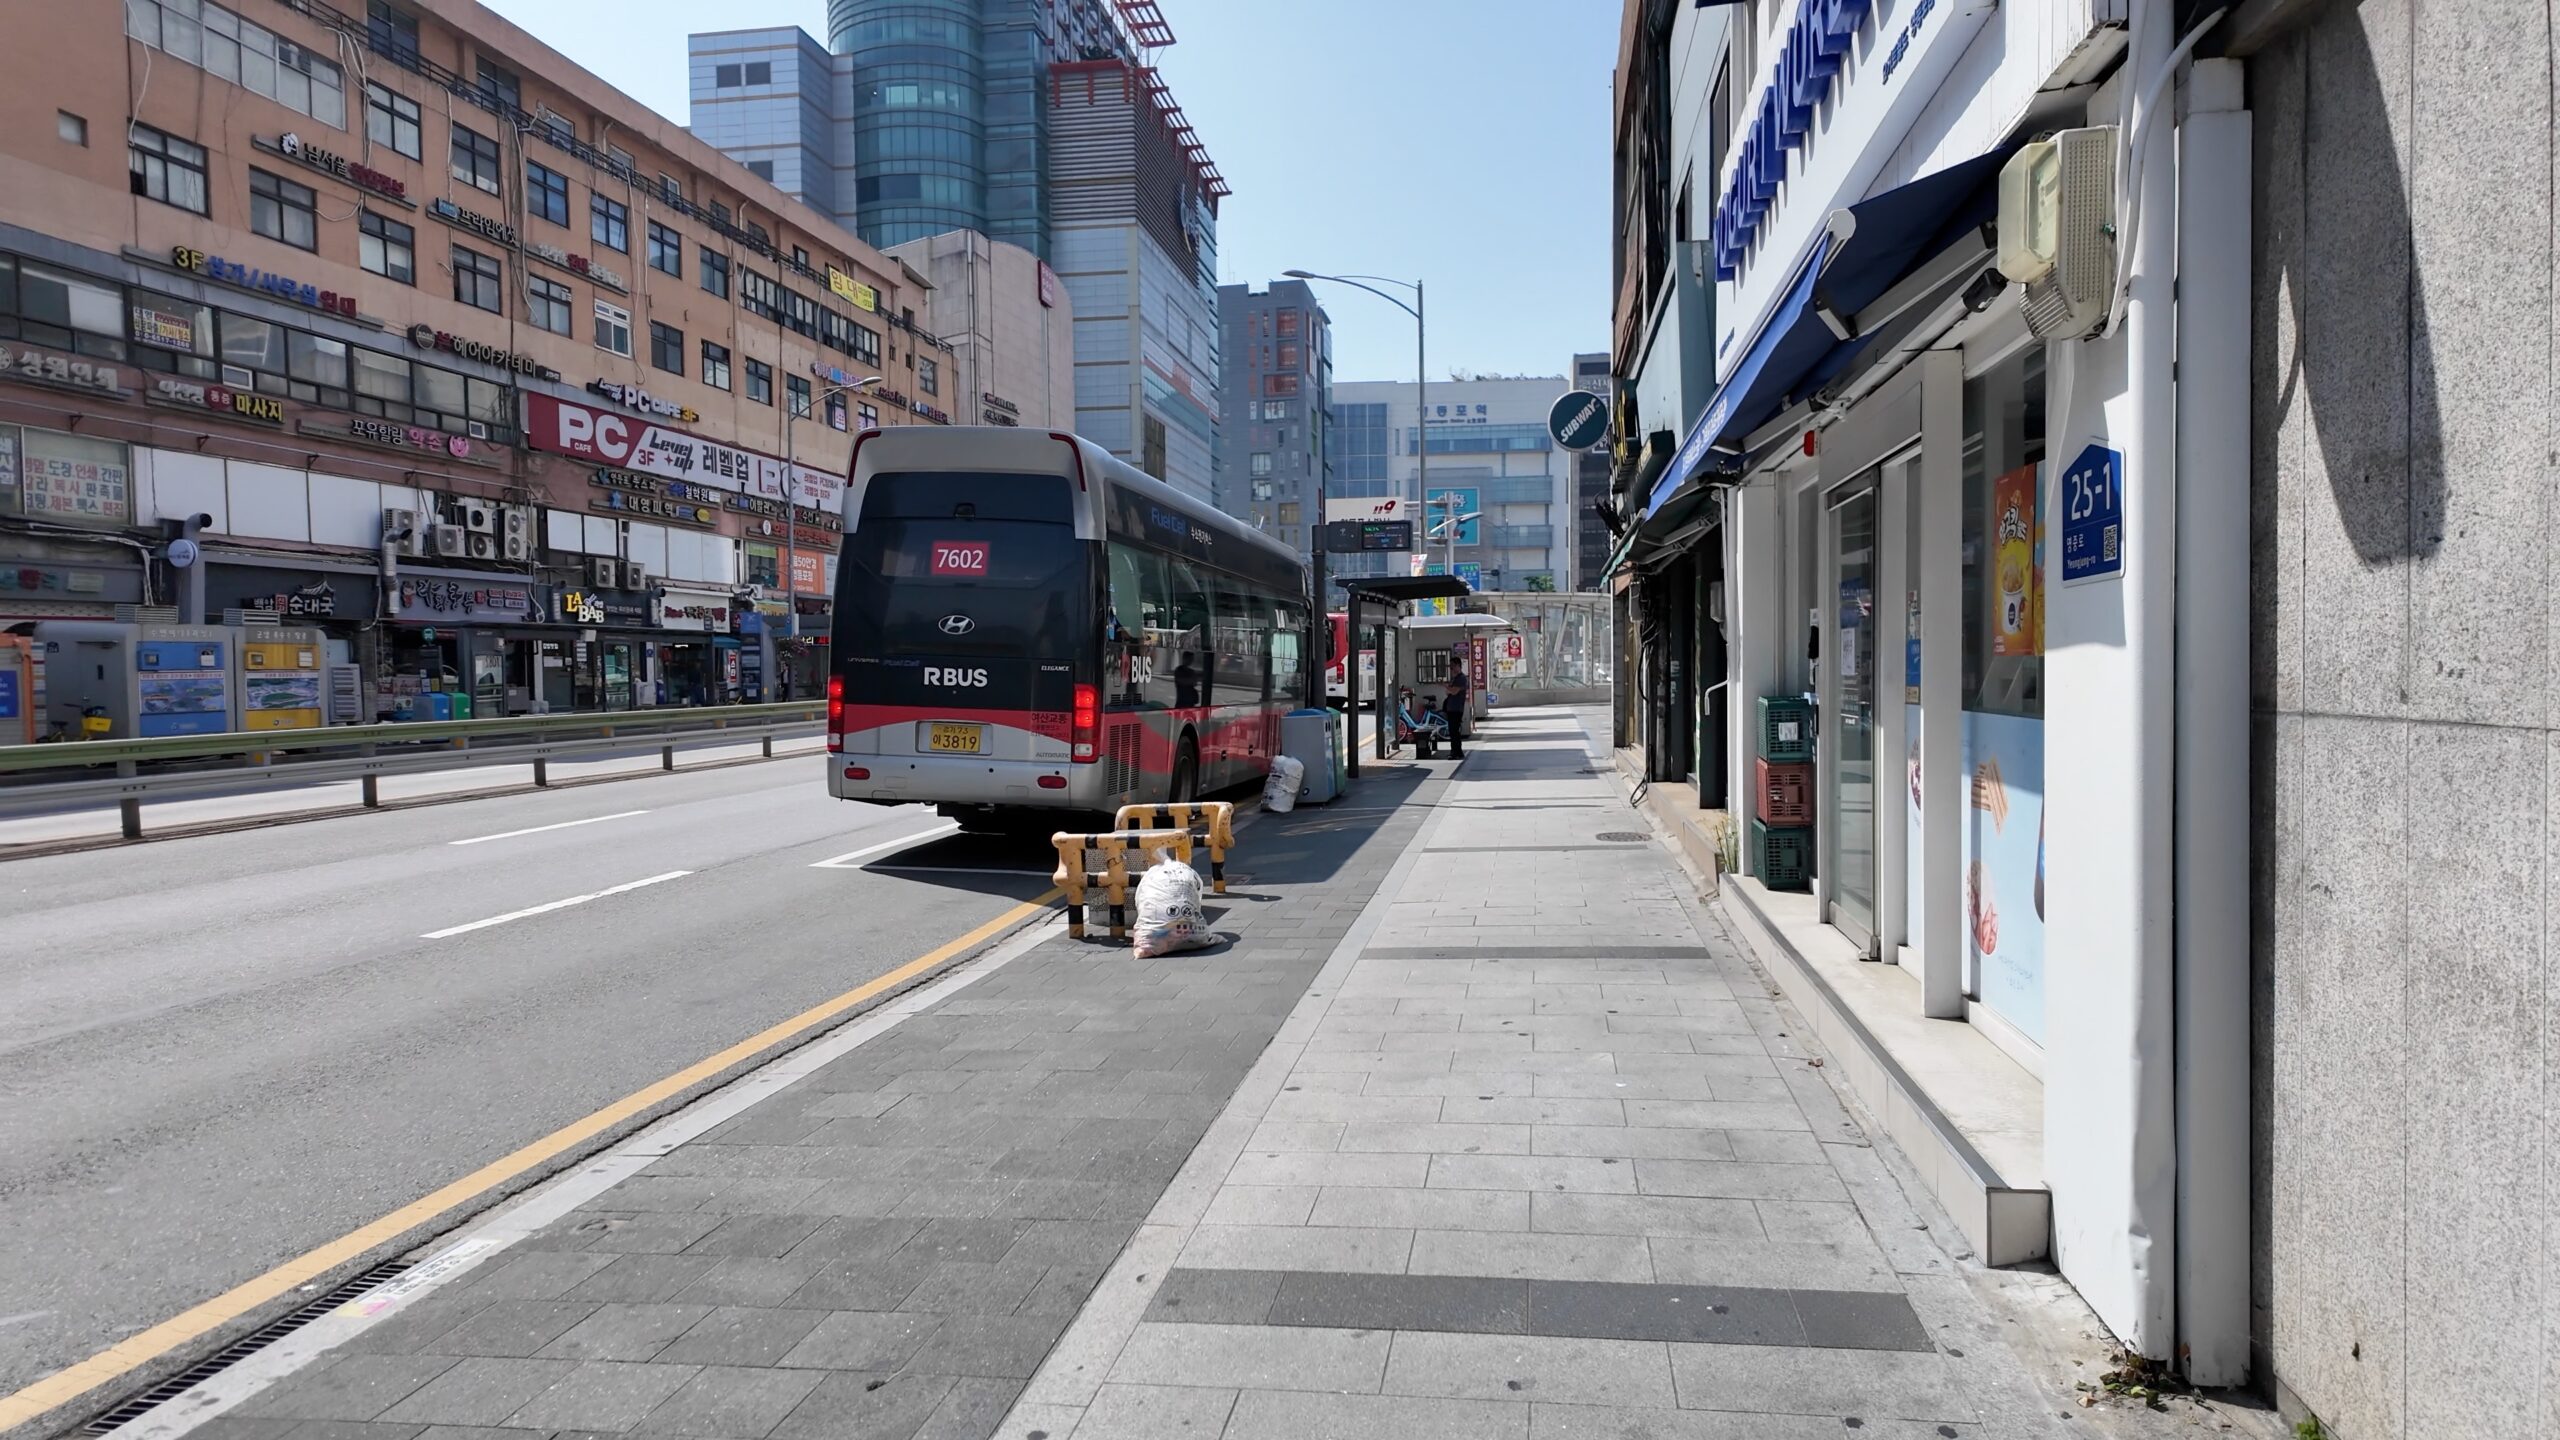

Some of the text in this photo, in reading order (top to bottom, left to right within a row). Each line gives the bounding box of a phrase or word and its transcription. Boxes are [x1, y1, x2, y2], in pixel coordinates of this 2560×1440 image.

[303, 142, 348, 177] 남서울
[175, 247, 204, 271] 3F
[453, 336, 536, 378] 헤어아카데미
[235, 394, 283, 422] 마사지
[625, 386, 650, 413] PC
[651, 400, 681, 418] CAFE
[681, 406, 699, 422] 3F
[1424, 404, 1488, 418] 등포역
[558, 403, 629, 460] PC
[1560, 397, 1597, 443] SUBWAY
[574, 442, 592, 453] CAFE
[638, 448, 655, 467] 3F
[702, 445, 750, 483] 레벨업
[2071, 462, 2111, 521] 25-1
[1373, 500, 1397, 513] 119
[937, 549, 984, 569] 7602
[289, 595, 335, 617] 순대국
[565, 591, 583, 613] LA
[577, 604, 605, 623] BAB
[923, 666, 988, 688] R BUS
[1131, 654, 1152, 683] BUS
[1035, 751, 1071, 759] AUTOMATIC
